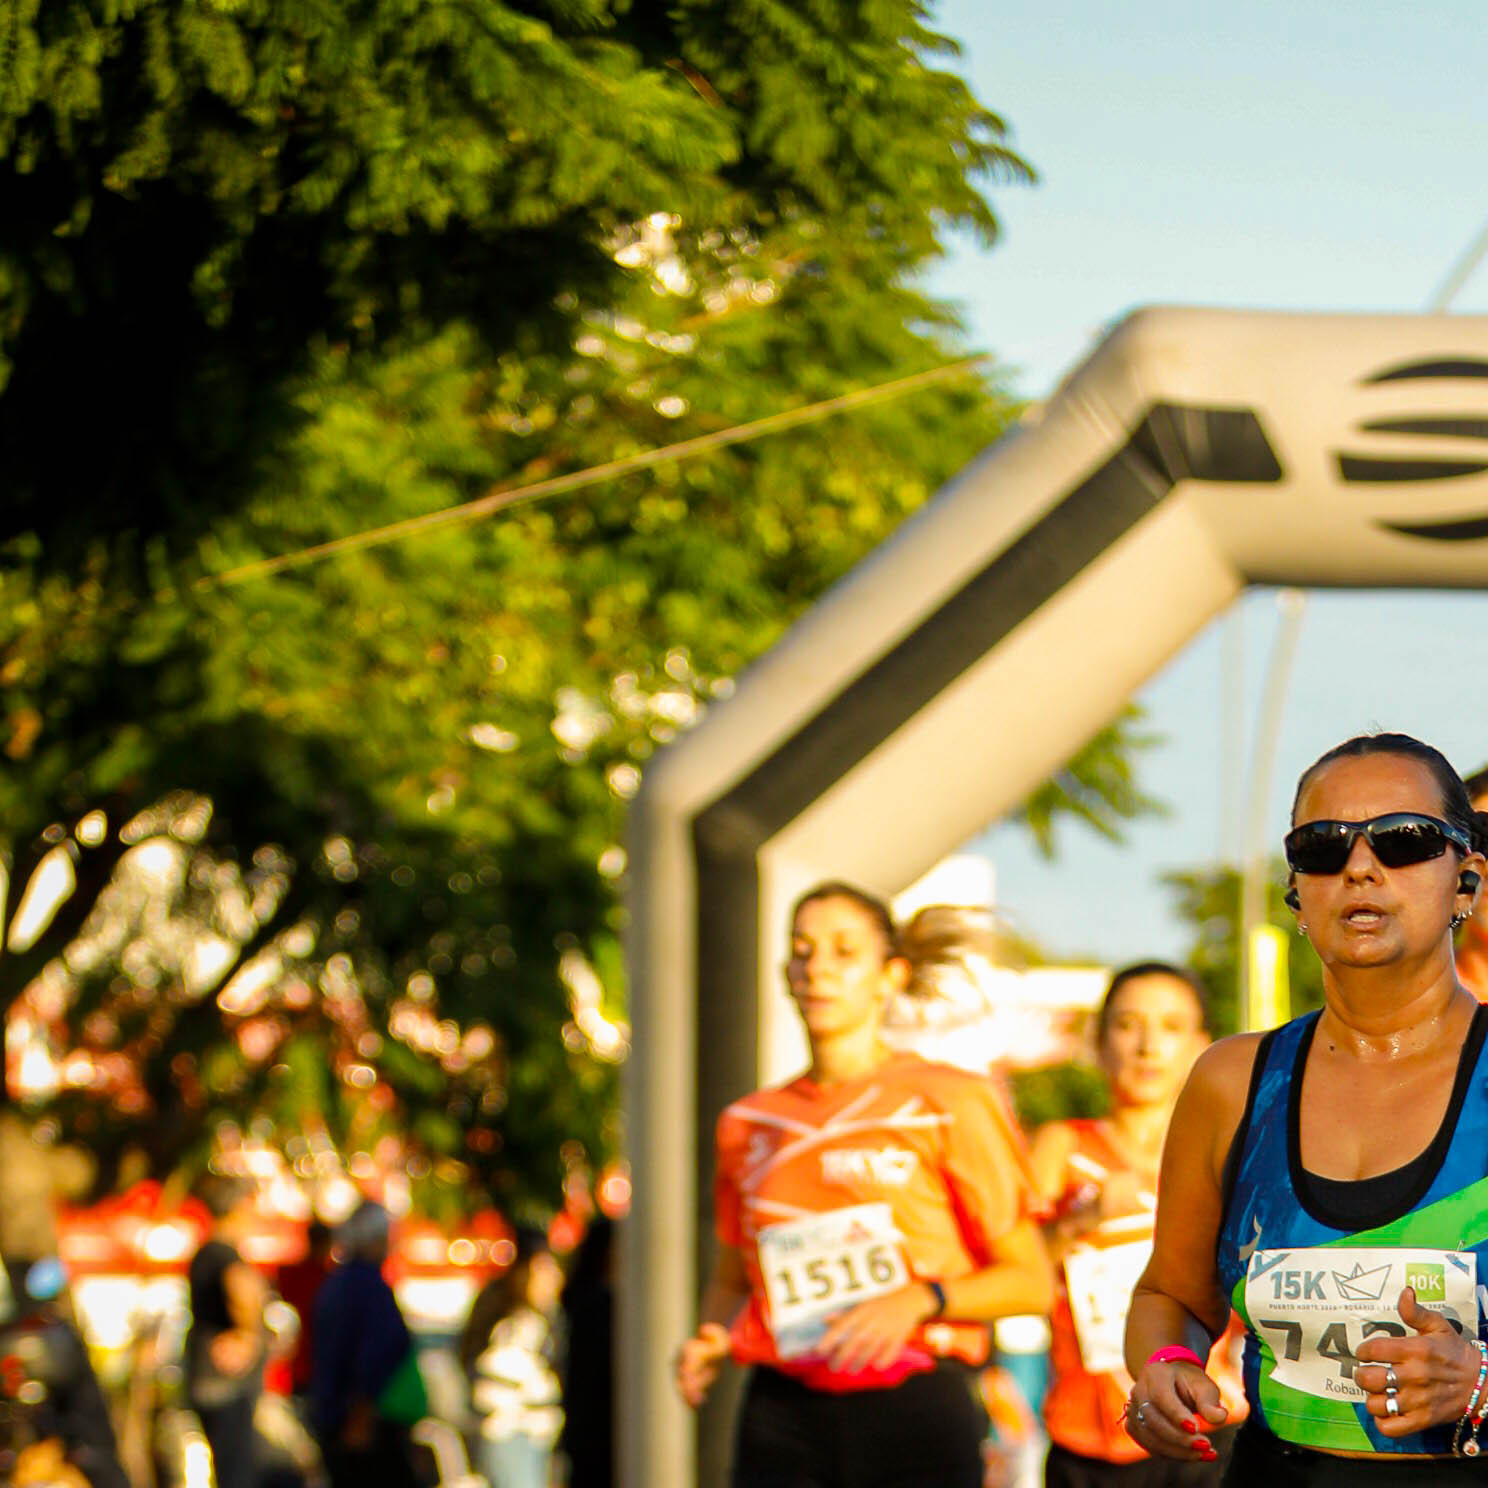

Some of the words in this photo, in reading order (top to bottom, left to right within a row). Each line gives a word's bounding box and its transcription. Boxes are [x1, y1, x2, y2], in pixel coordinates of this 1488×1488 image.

[777, 1245, 896, 1304] 1516
[1269, 1270, 1327, 1300] 15K
[1409, 1273, 1442, 1291] 10K
